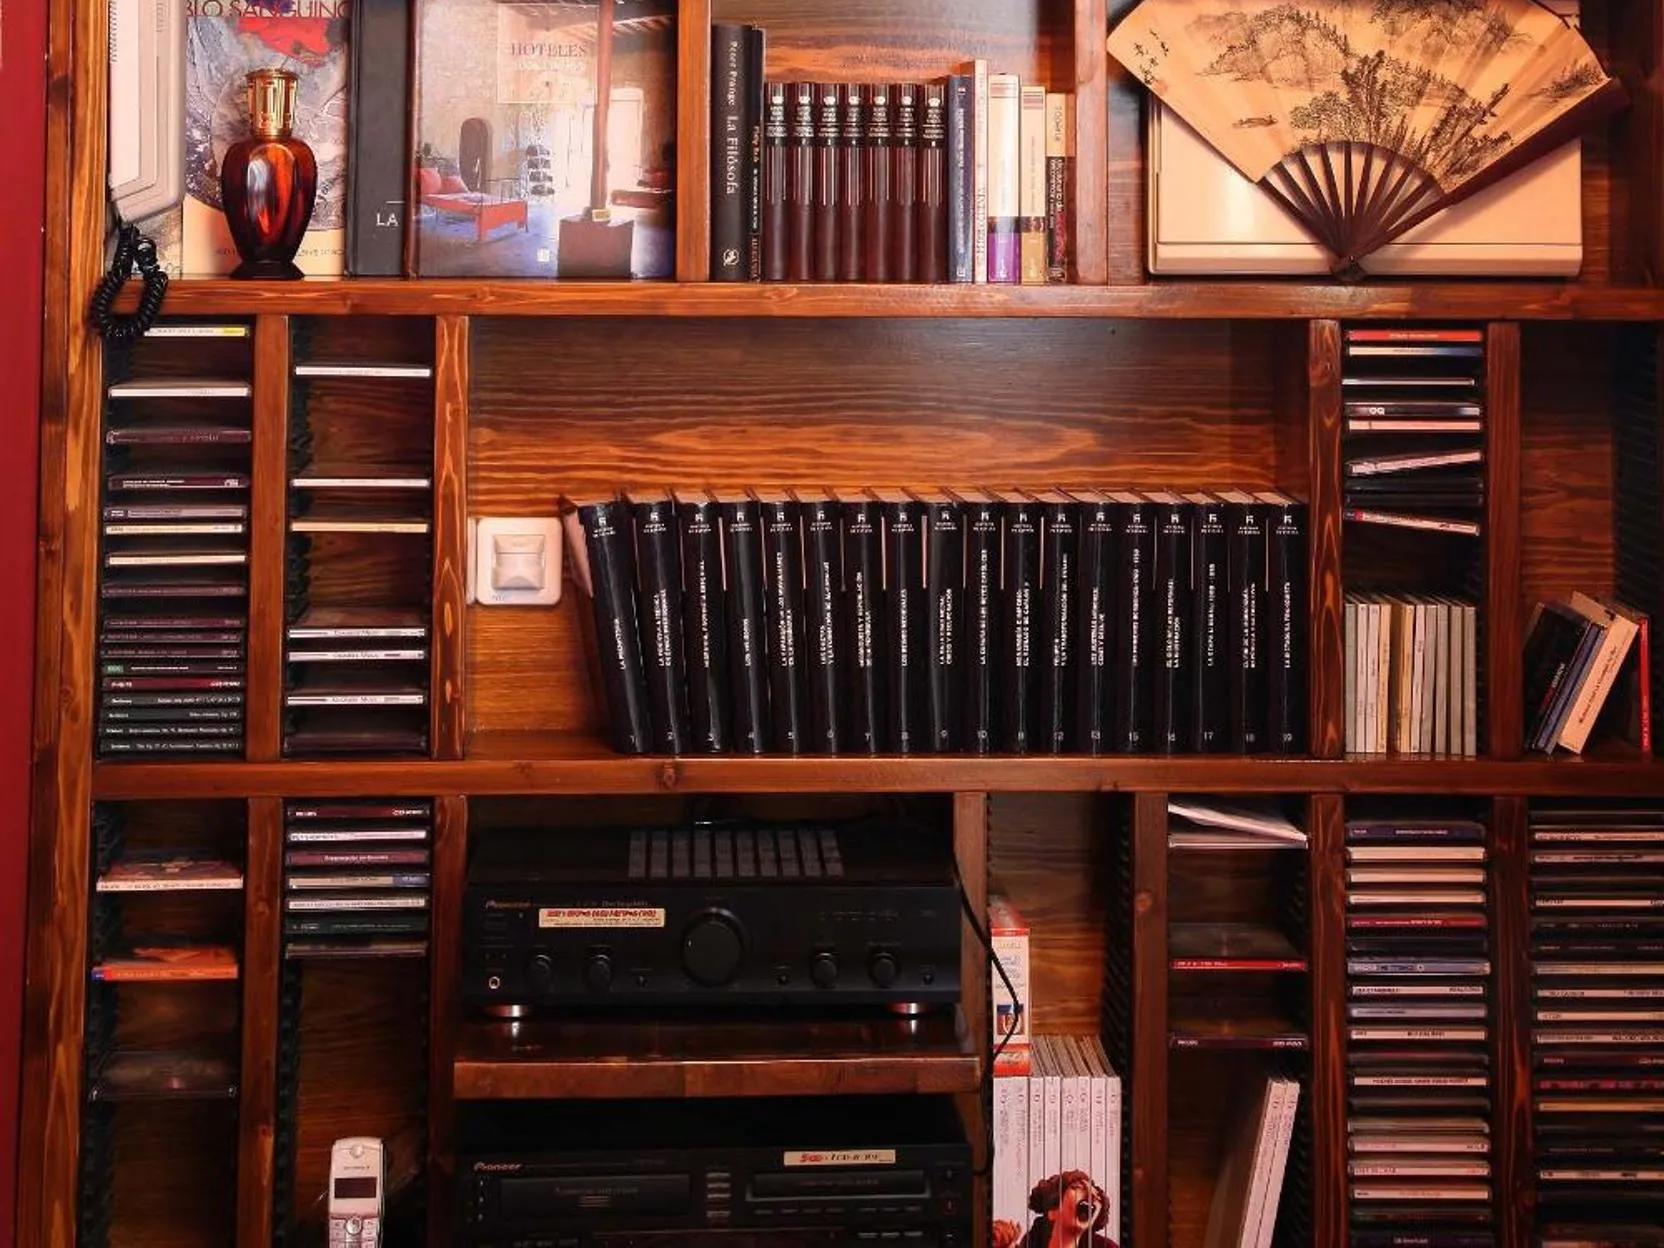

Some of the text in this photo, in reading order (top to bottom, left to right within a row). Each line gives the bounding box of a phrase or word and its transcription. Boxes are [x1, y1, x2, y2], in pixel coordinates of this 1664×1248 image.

[186, 0, 222, 17] BLO
[511, 43, 588, 57] HOTELES
[727, 70, 738, 106] Prange
[726, 115, 739, 194] La Filósofa
[977, 729, 988, 740] 10
[1203, 730, 1214, 741] 17
